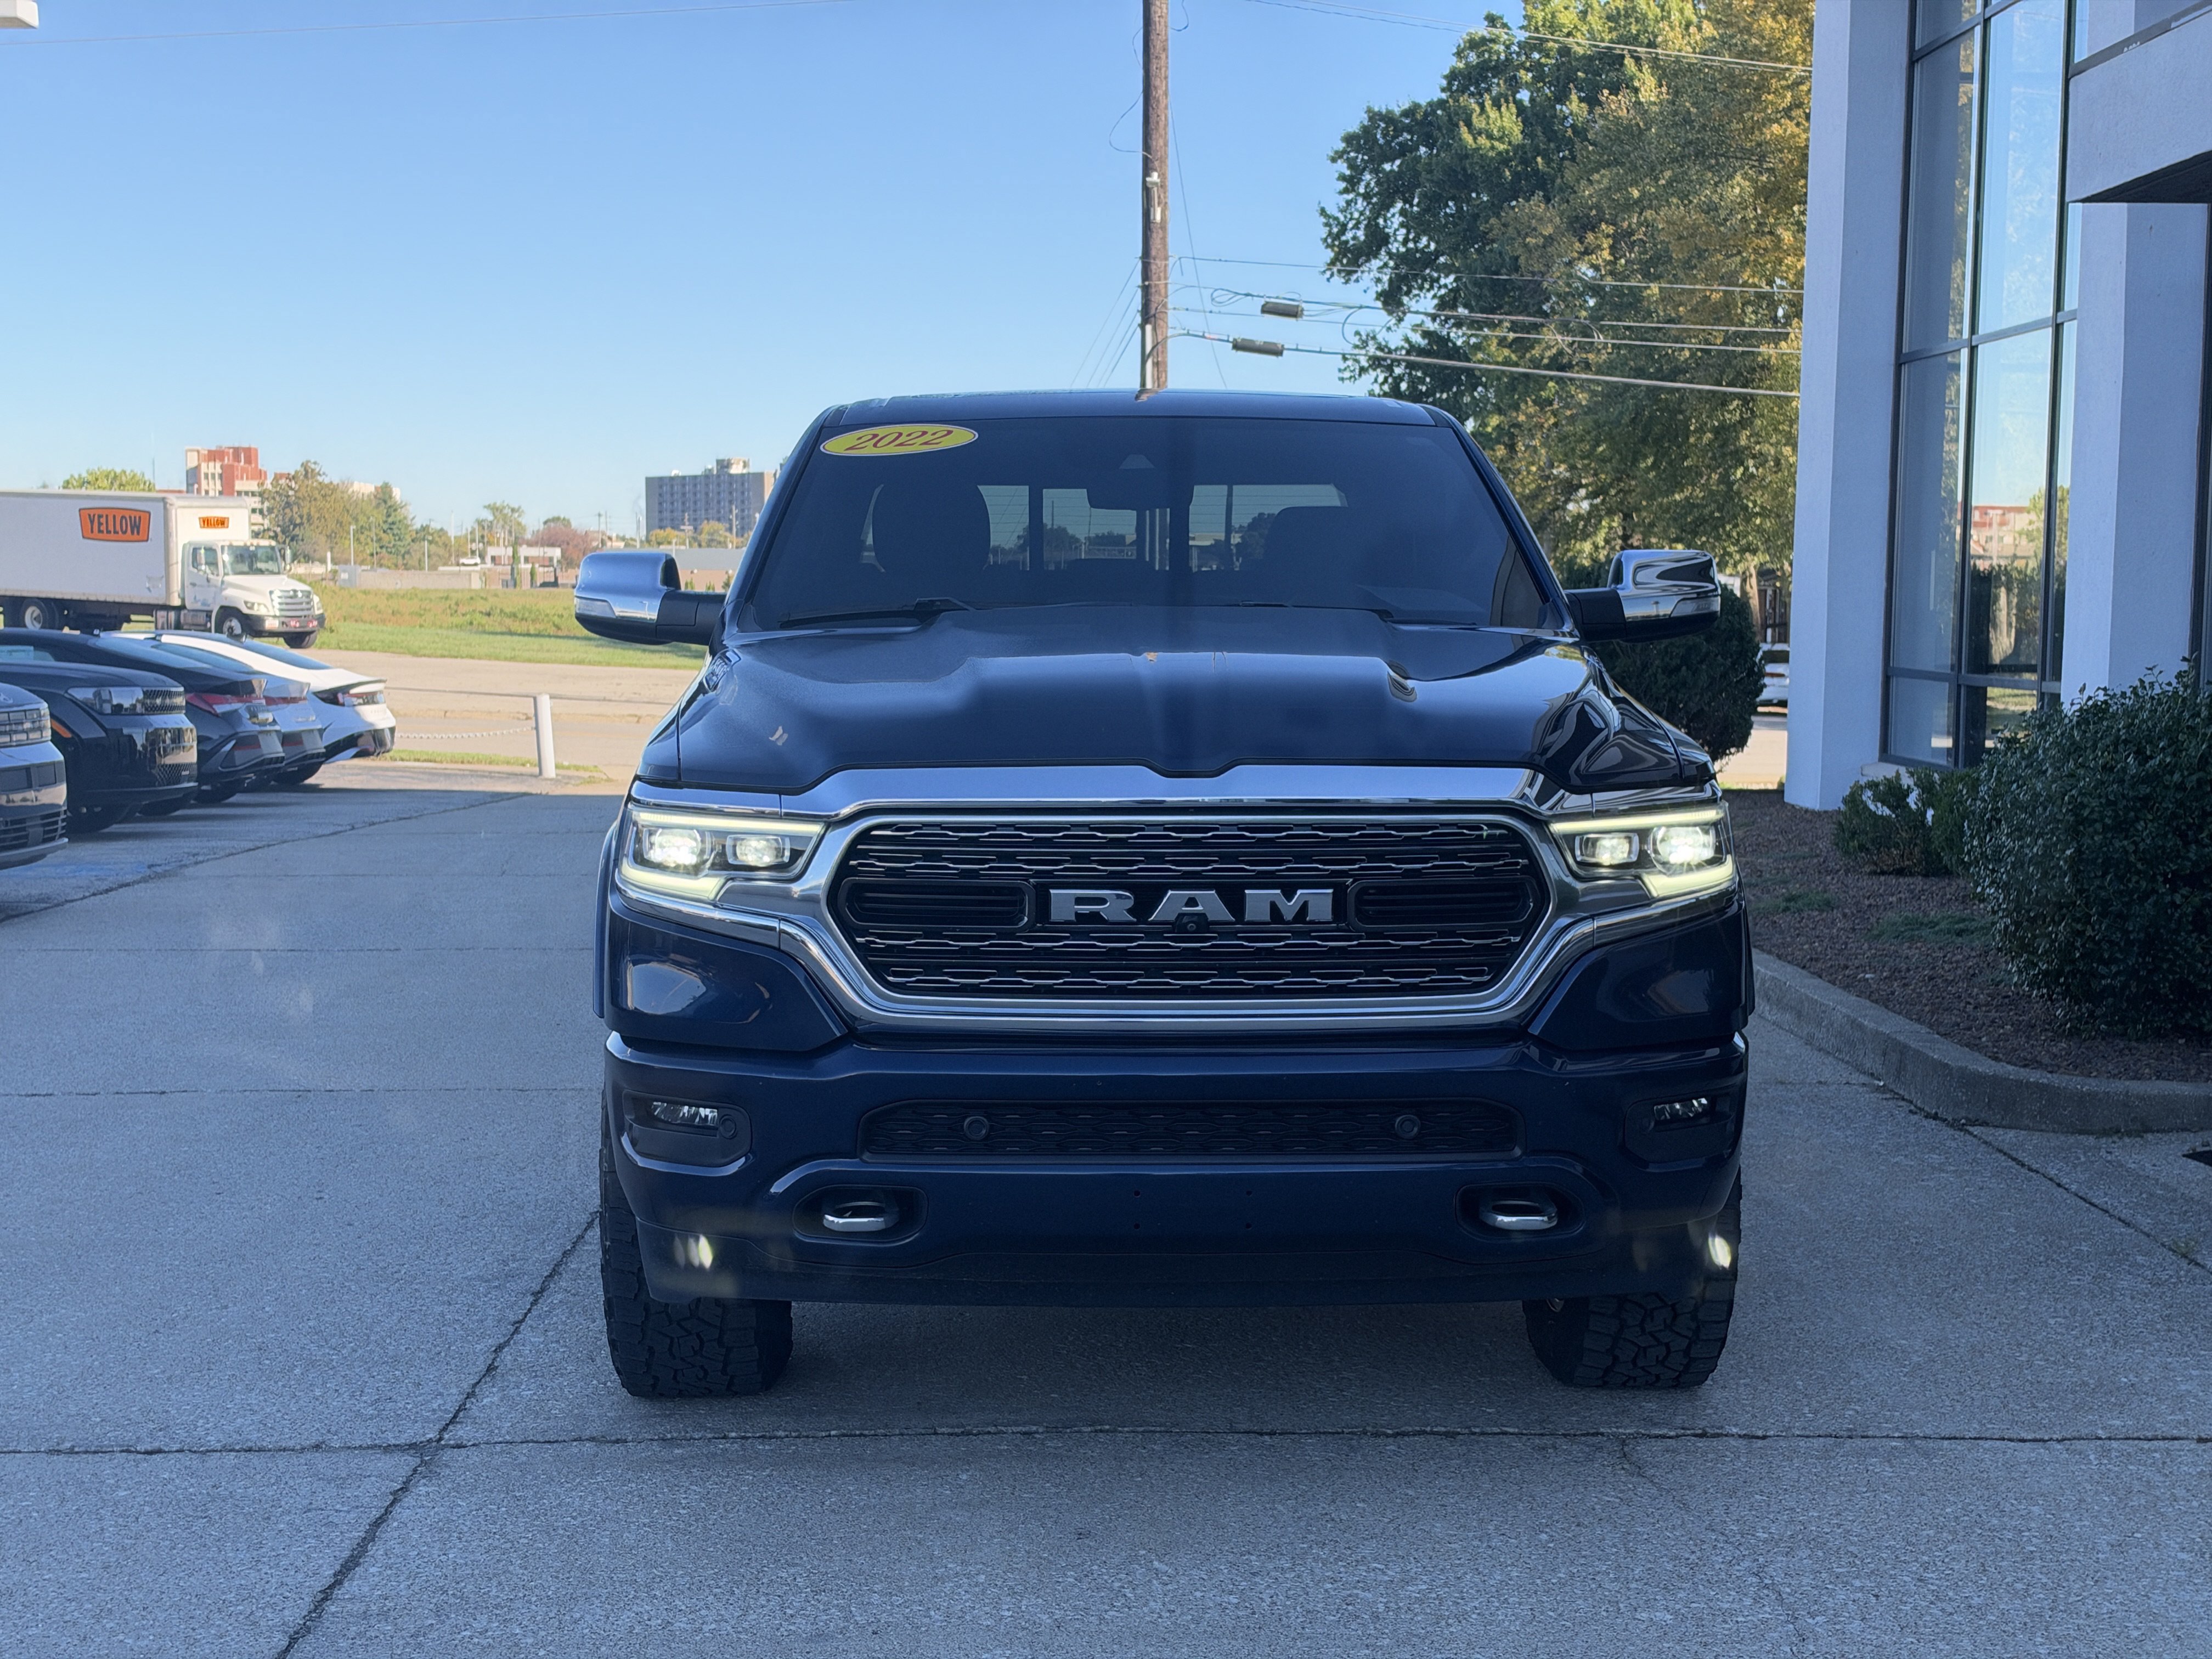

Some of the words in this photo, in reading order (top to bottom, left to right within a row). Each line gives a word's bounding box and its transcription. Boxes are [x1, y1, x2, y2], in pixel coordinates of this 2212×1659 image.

[844, 430, 953, 452] 2022
[88, 513, 142, 536] YELLOW
[202, 517, 225, 527] YELLOW
[1049, 889, 1334, 922] RAM
